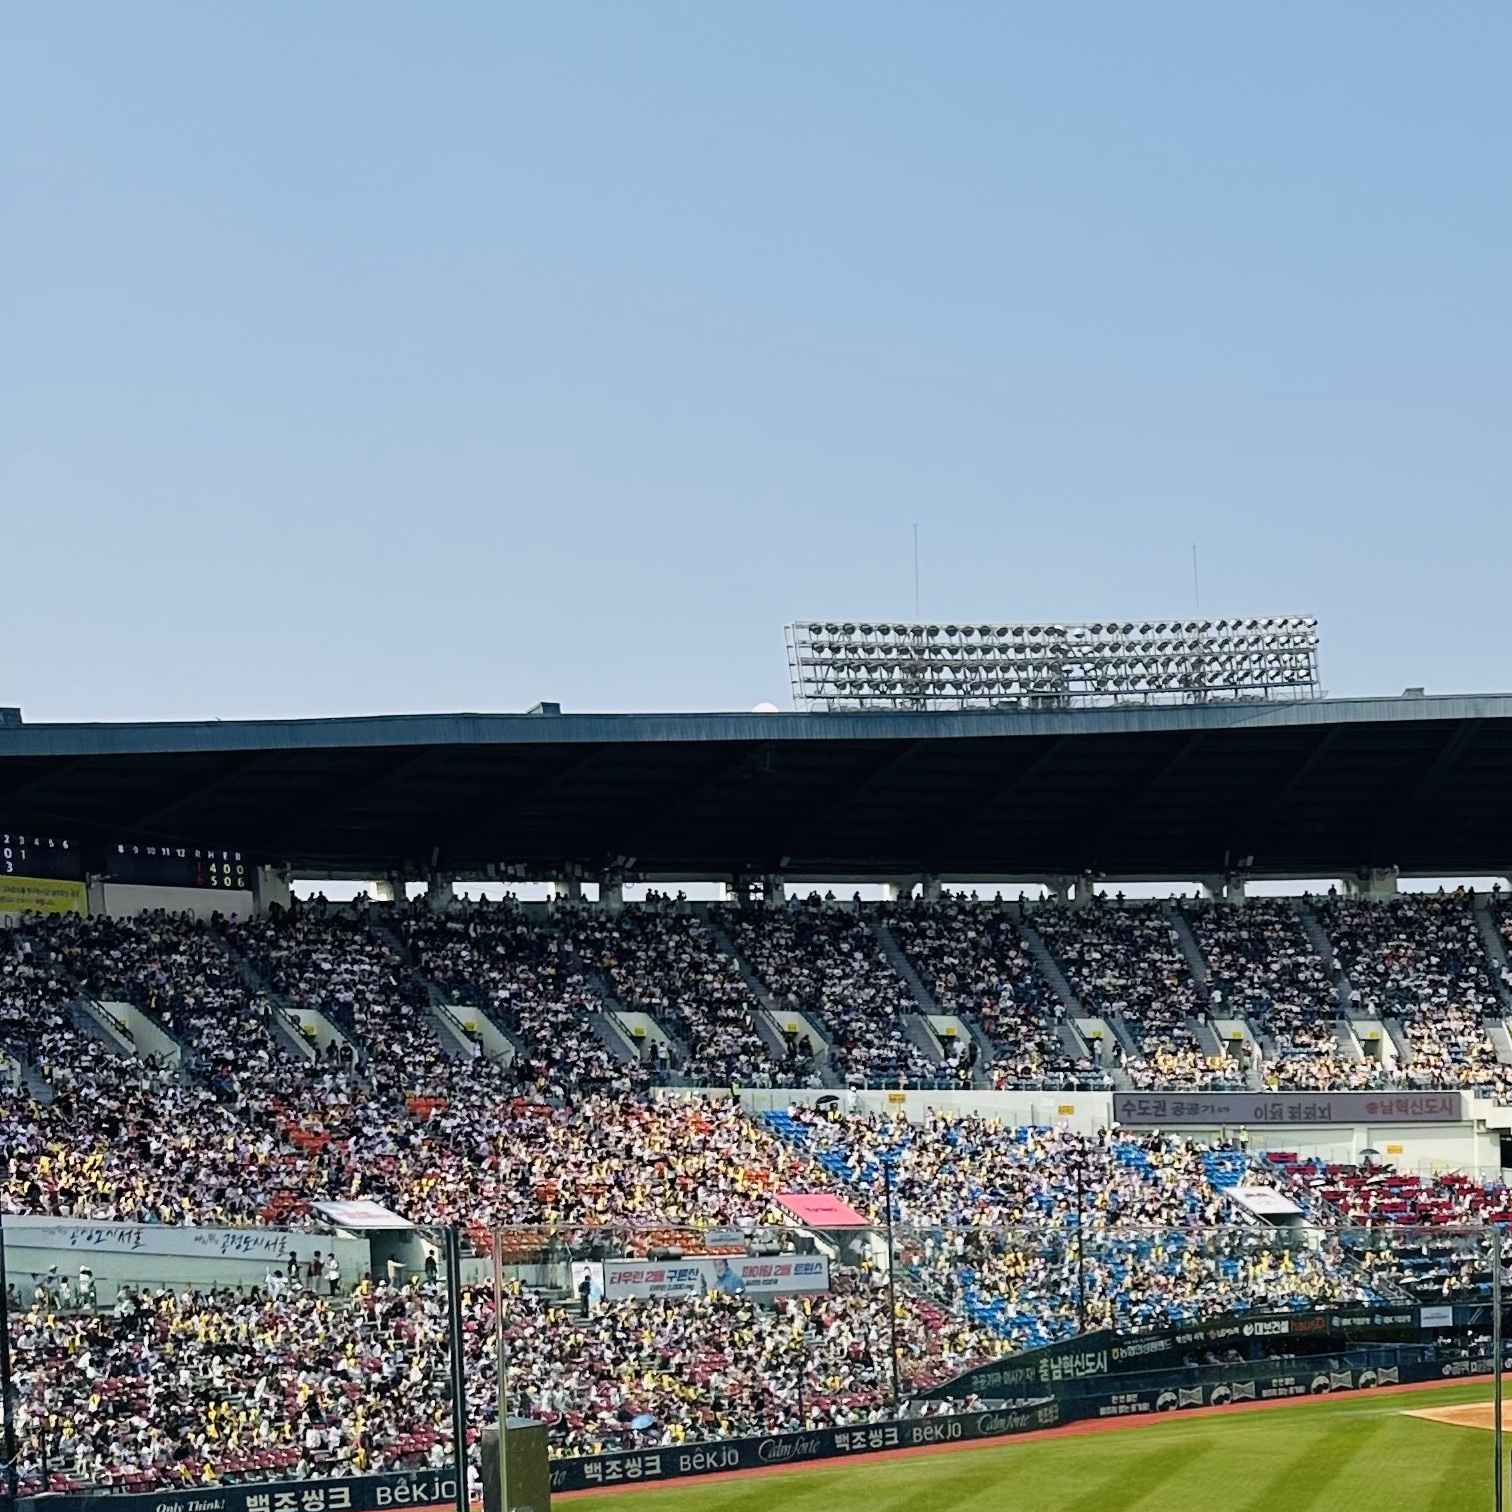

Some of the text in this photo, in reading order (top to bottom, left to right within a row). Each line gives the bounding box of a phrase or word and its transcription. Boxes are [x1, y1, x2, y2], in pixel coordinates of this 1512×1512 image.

[4, 848, 12, 859] 0
[162, 848, 170, 856] 11
[6, 861, 13, 872] 3
[209, 863, 217, 873] 4
[223, 864, 231, 874] 0
[236, 865, 244, 875] 0
[211, 876, 245, 888] 5 0 6
[834, 1426, 899, 1452] 백조씽크
[584, 1454, 662, 1482] 백조씽크
[187, 1499, 226, 1512] Think!
